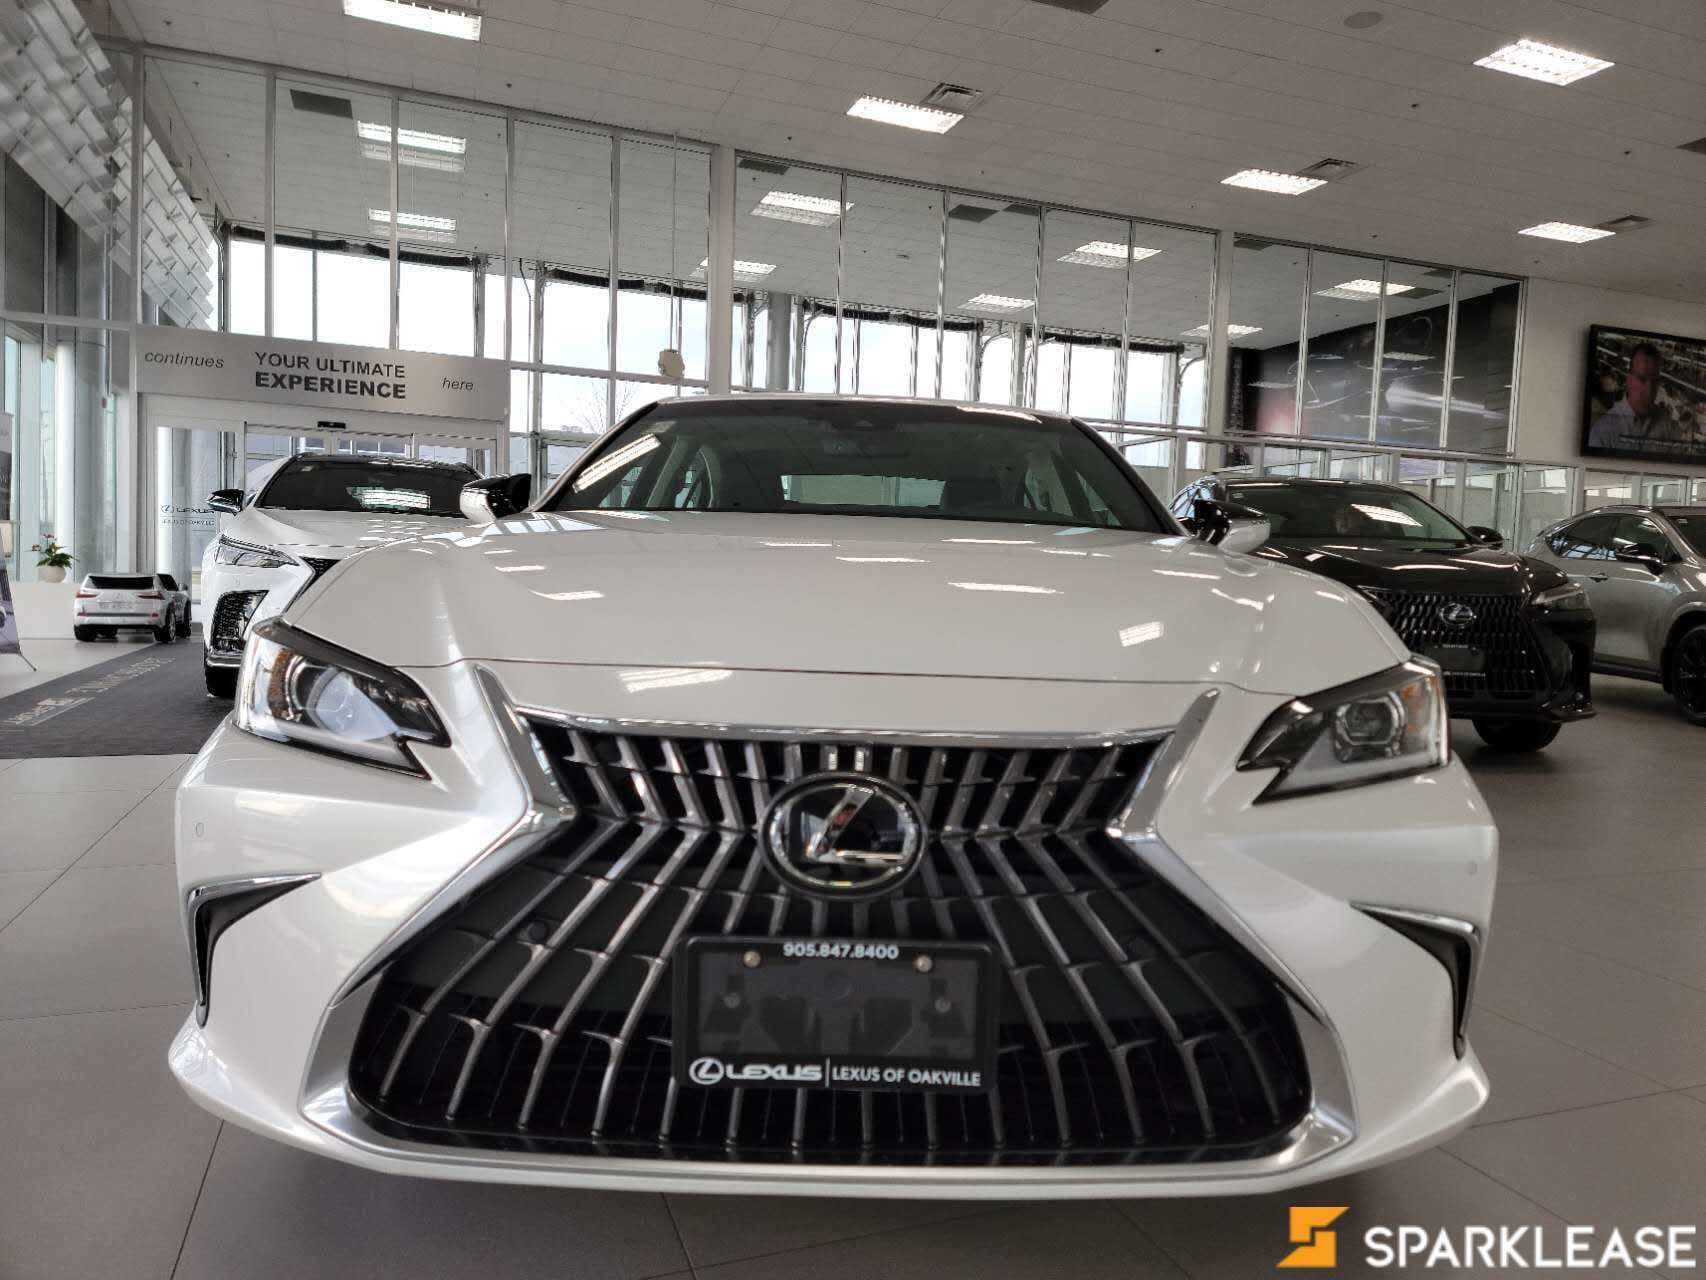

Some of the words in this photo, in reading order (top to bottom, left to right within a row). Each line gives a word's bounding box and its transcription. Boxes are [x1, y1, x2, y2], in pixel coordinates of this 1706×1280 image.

[144, 351, 225, 369] continues
[255, 351, 310, 370] YOUR
[316, 357, 406, 379] ULTIMATE
[255, 371, 406, 399] EXPERIENCE
[442, 377, 474, 391] here
[783, 941, 900, 959] 905.847.8400
[725, 1064, 823, 1081] LEXUS
[832, 1066, 880, 1082] LEXUS
[883, 1068, 904, 1083] OF
[908, 1069, 981, 1088] OAKVILLE
